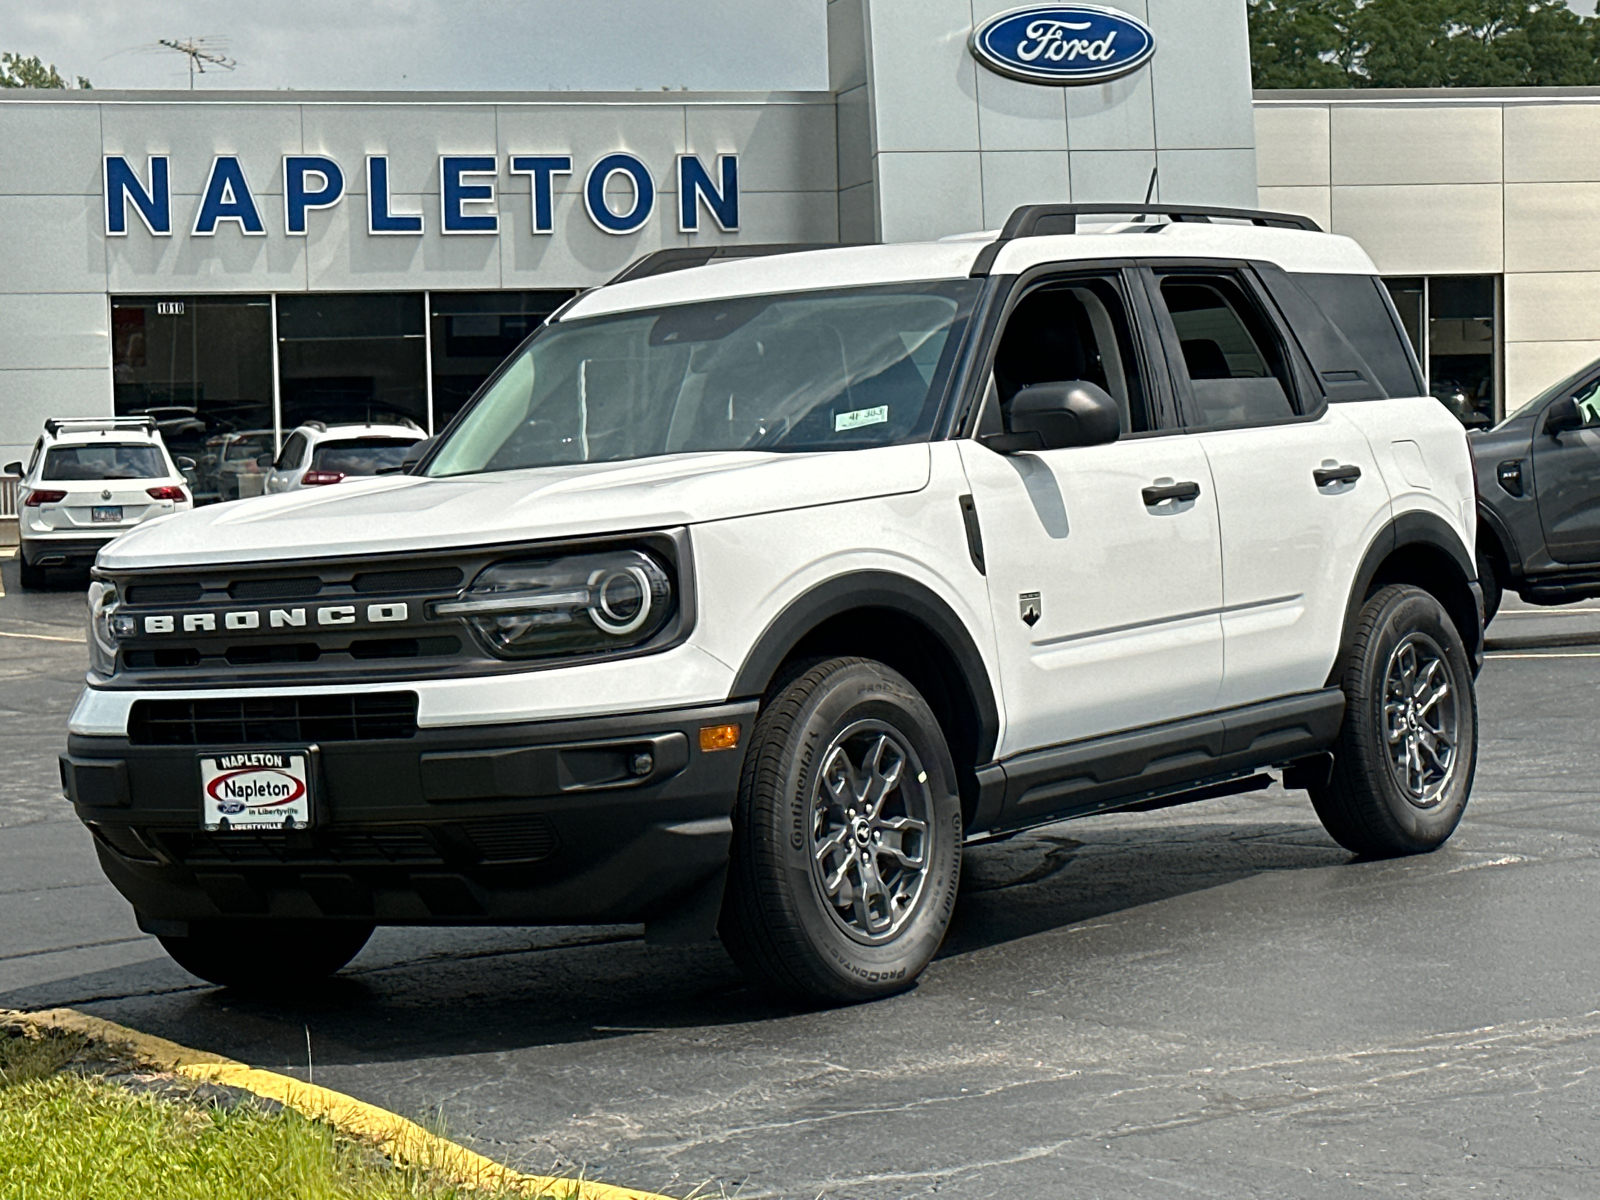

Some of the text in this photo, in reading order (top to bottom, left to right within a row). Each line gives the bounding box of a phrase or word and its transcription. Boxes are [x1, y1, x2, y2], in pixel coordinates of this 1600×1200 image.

[1016, 19, 1118, 62] Ford
[101, 152, 742, 237] NAPLETON
[159, 302, 184, 314] 1010
[144, 602, 409, 634] BRONCO
[221, 753, 283, 769] NAPLETON
[223, 778, 291, 802] Napleton
[248, 806, 299, 816] in Libertyville
[229, 822, 283, 831] LIBERTYVILLE
